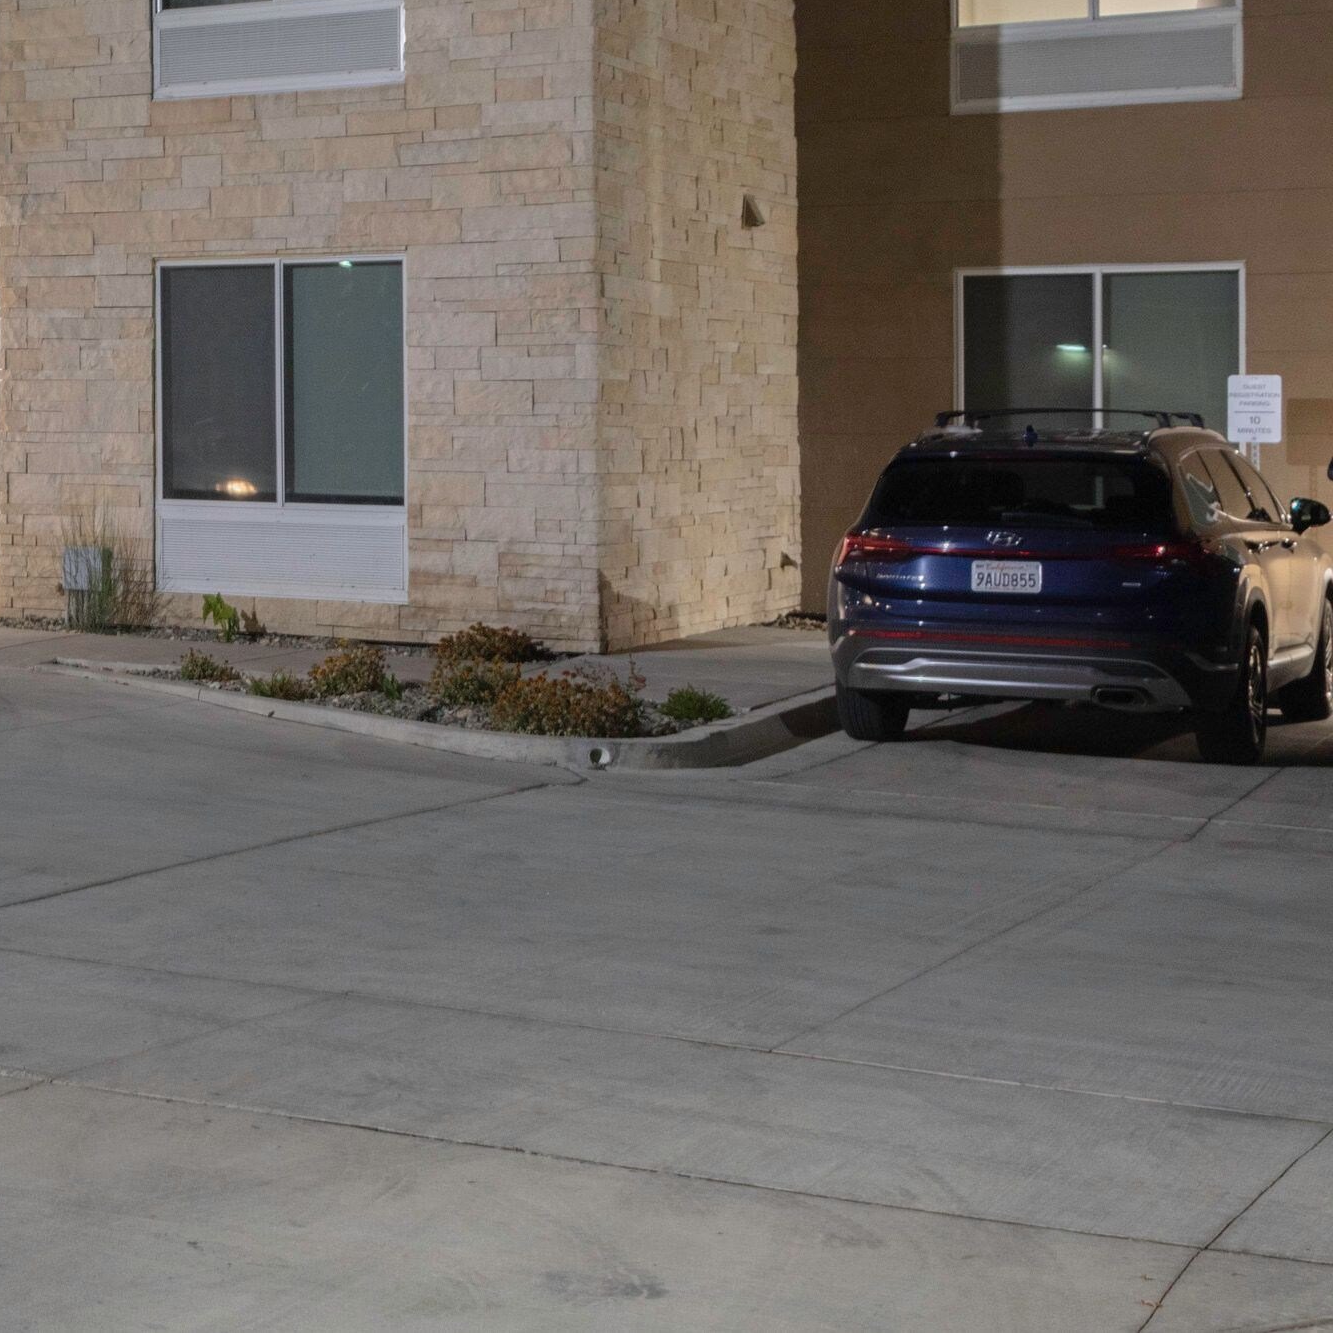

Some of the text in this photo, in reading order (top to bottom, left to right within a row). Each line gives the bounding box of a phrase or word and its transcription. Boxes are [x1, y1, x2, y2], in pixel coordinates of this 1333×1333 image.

[1249, 416, 1261, 425] 10
[1237, 427, 1273, 435] MINUTES
[976, 572, 1037, 588] 9AUD855
